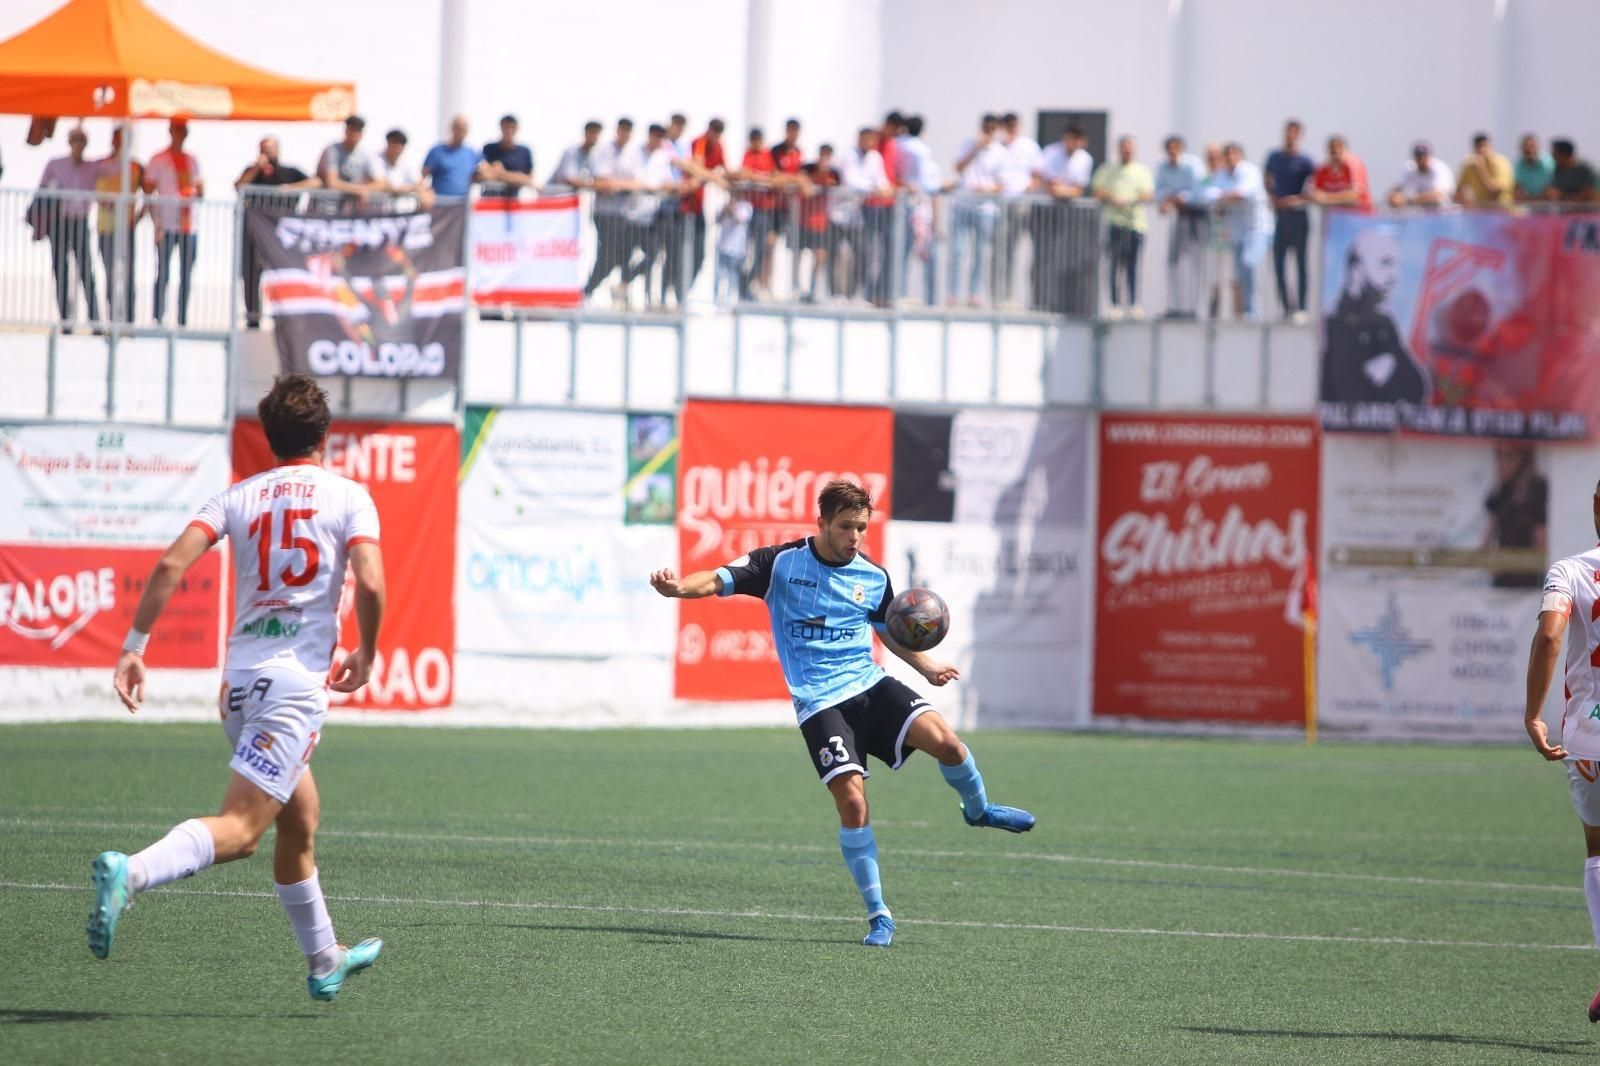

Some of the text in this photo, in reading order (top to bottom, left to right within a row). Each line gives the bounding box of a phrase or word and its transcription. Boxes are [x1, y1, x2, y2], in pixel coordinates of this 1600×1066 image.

[323, 432, 417, 482] ENTE
[273, 482, 315, 499] ORTIZ
[681, 455, 888, 540] gutiérrz
[248, 508, 320, 592] 15
[788, 577, 818, 589] LEGEA
[828, 735, 850, 763] 3
